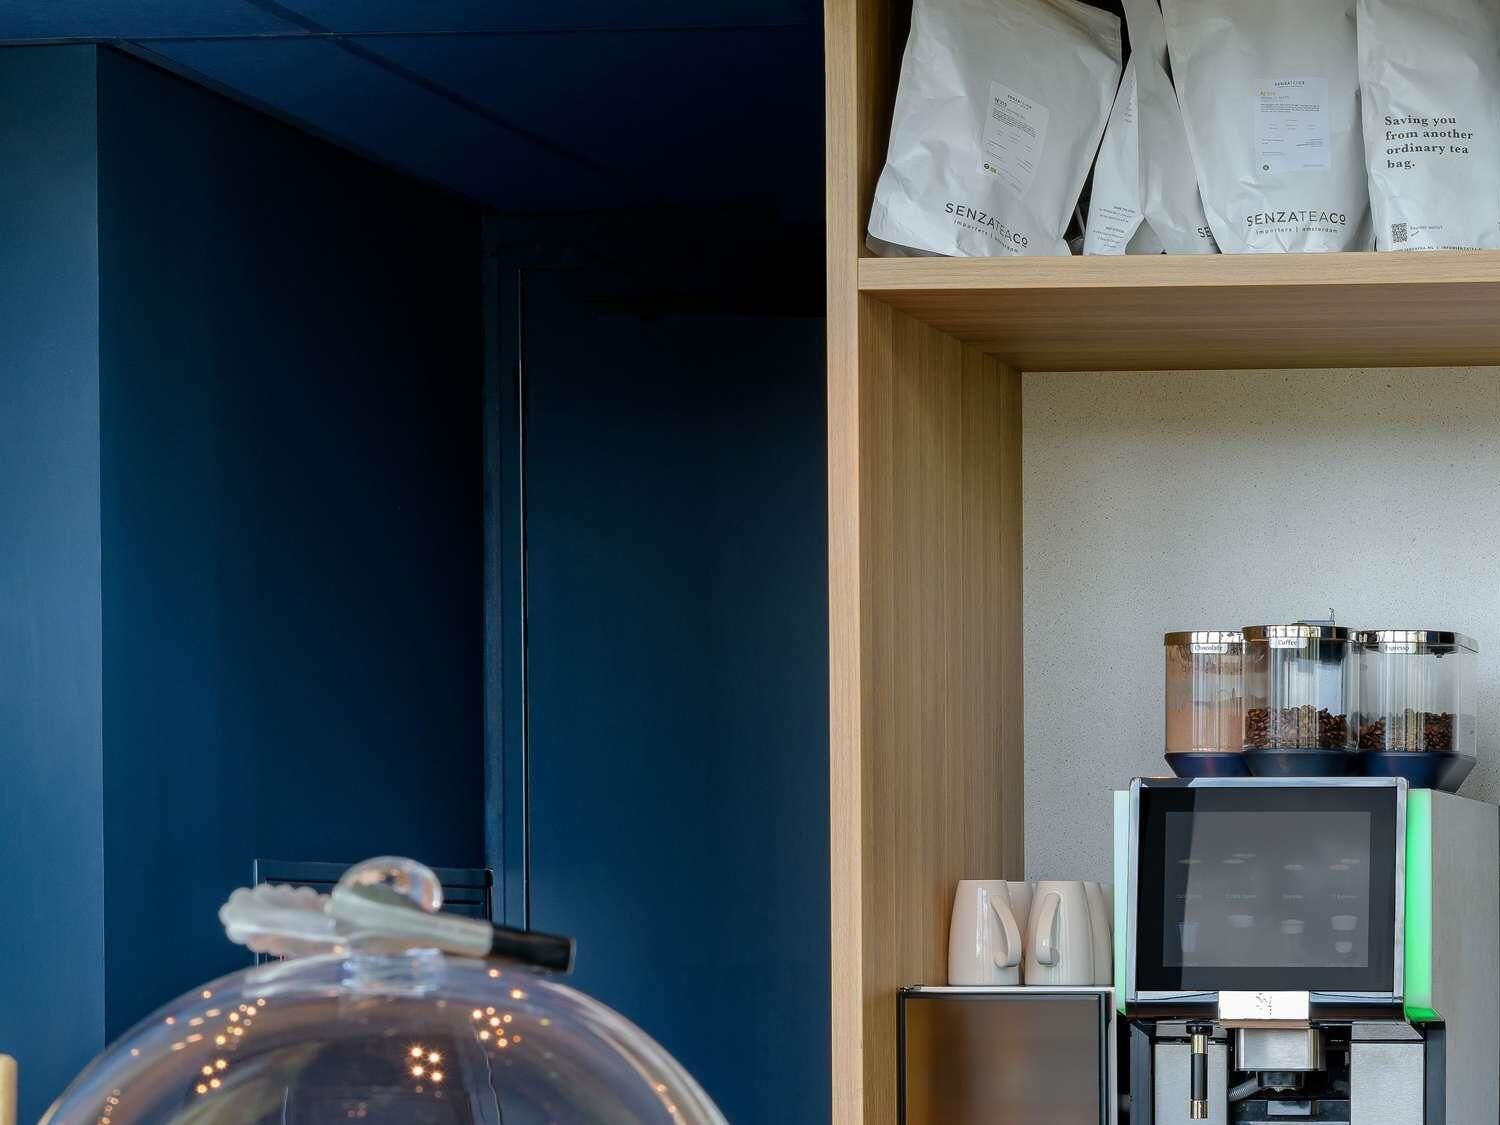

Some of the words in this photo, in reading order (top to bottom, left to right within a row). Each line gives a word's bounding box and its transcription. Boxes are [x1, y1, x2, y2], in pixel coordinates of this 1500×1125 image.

[1384, 115, 1429, 127] Saving
[1432, 117, 1457, 127] you
[1385, 129, 1418, 141] from
[1423, 129, 1474, 139] another
[1386, 143, 1445, 155] ordinary
[1450, 145, 1469, 154] tea
[1386, 159, 1415, 170] bag.
